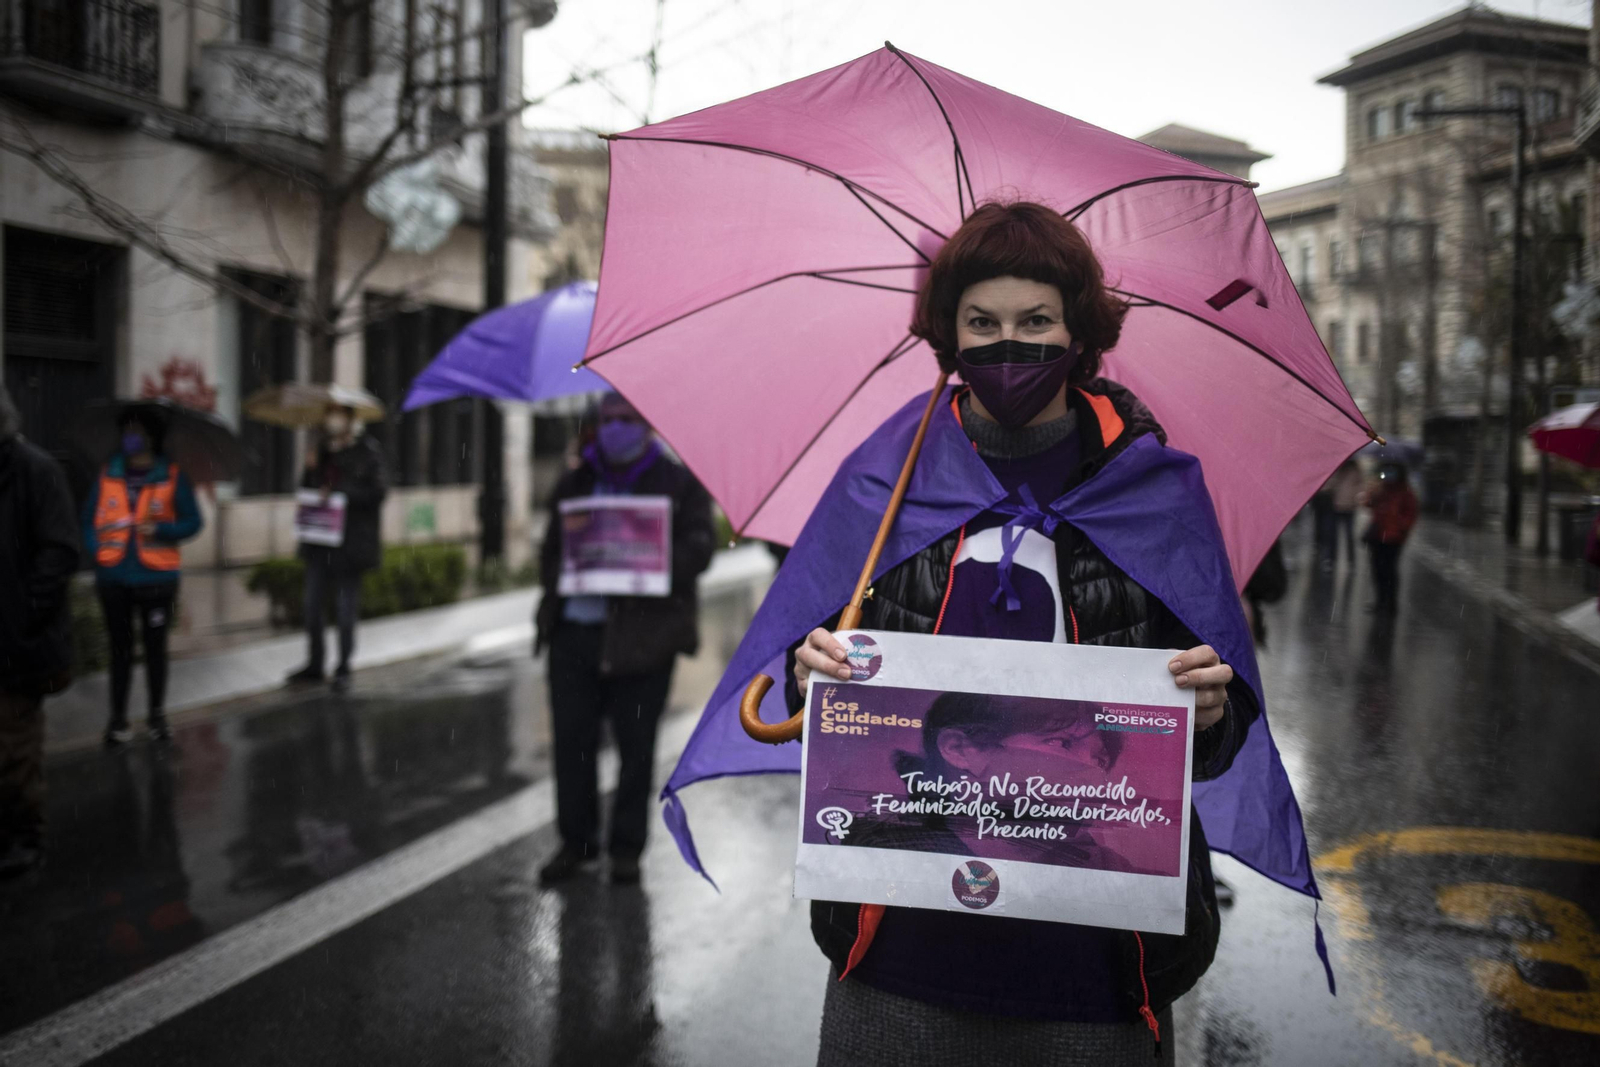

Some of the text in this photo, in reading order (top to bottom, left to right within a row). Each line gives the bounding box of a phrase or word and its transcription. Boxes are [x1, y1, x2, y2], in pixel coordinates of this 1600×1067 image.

[822, 698, 859, 711] Los
[1102, 706, 1171, 718] Feminismos
[820, 710, 923, 729] Cuidados
[1095, 713, 1178, 728] PODEMOS
[820, 721, 870, 736] Son:
[900, 771, 1136, 806] Trabajo No Reconocido
[871, 792, 1171, 829] Feminizados, Desvalorizados,
[976, 816, 1068, 840] Precarios
[961, 895, 988, 904] PODEMOS
